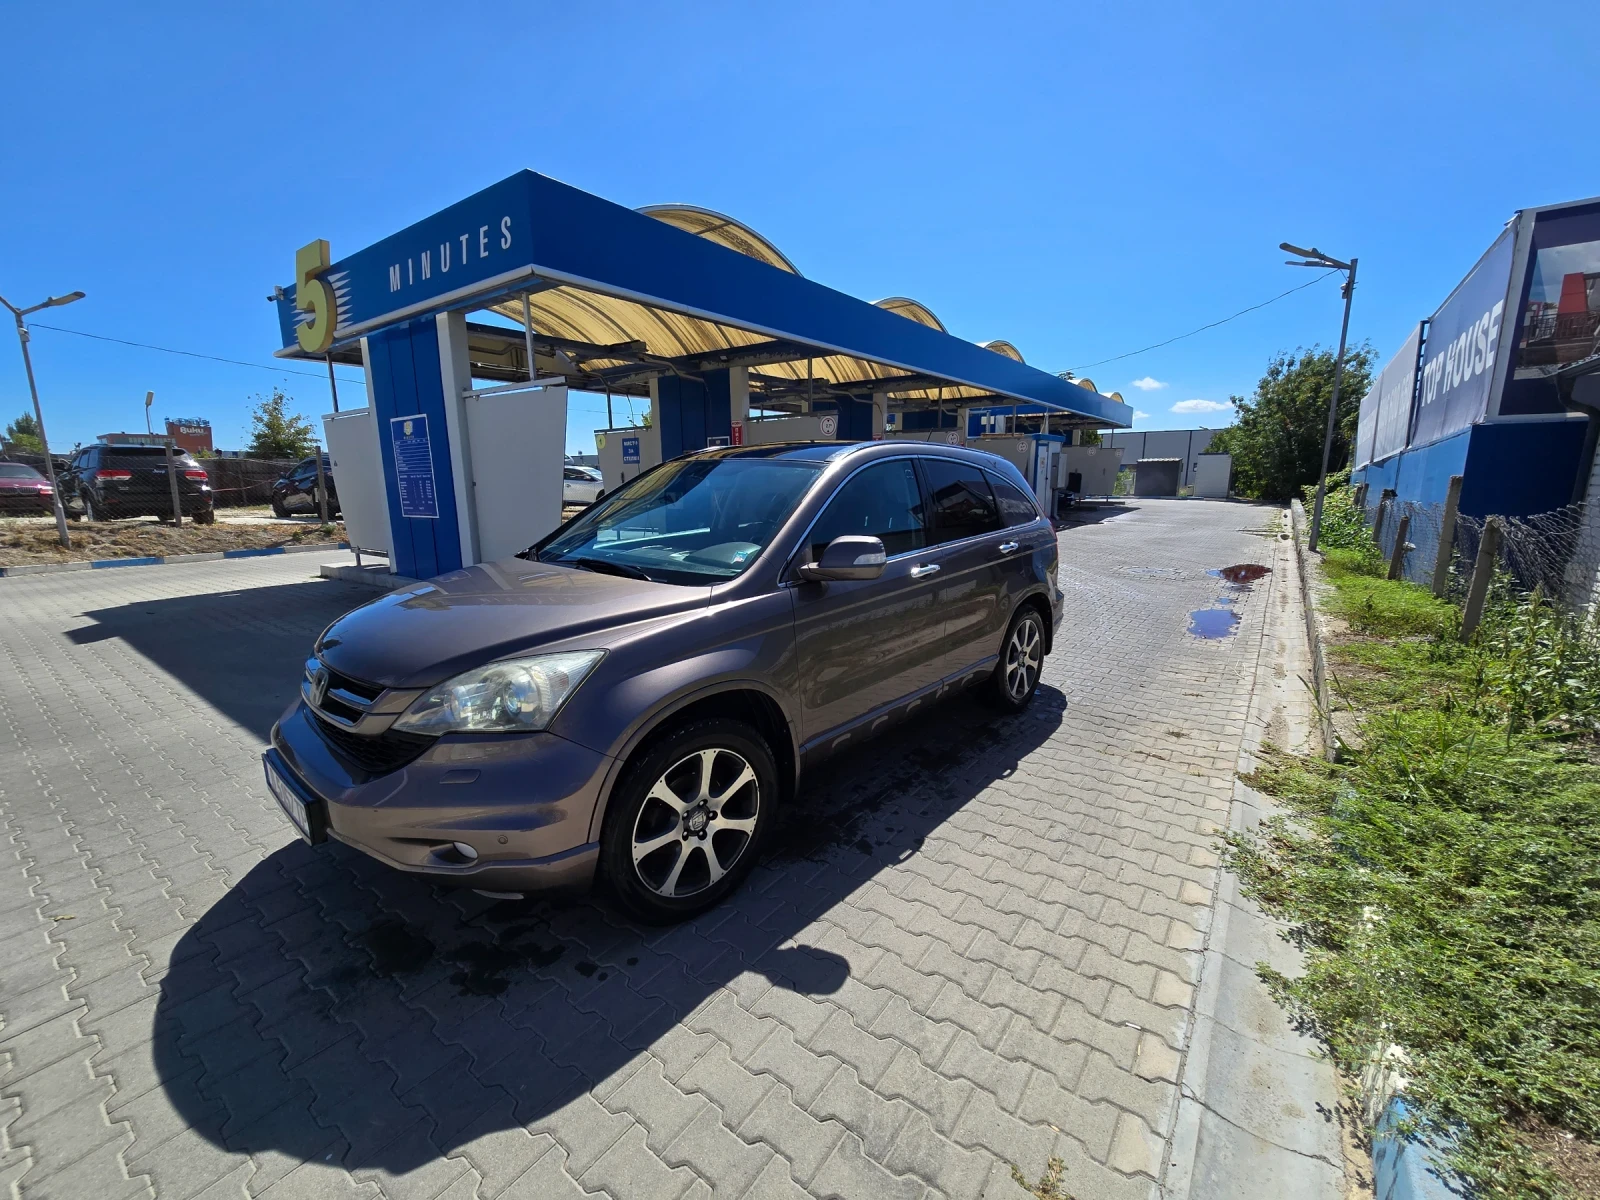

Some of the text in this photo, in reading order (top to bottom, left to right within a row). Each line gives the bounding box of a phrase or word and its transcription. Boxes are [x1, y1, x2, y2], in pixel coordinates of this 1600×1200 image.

[295, 216, 512, 353] 5 MINUTES
[1421, 351, 1445, 407] TOP
[1442, 299, 1504, 395] HOUSE
